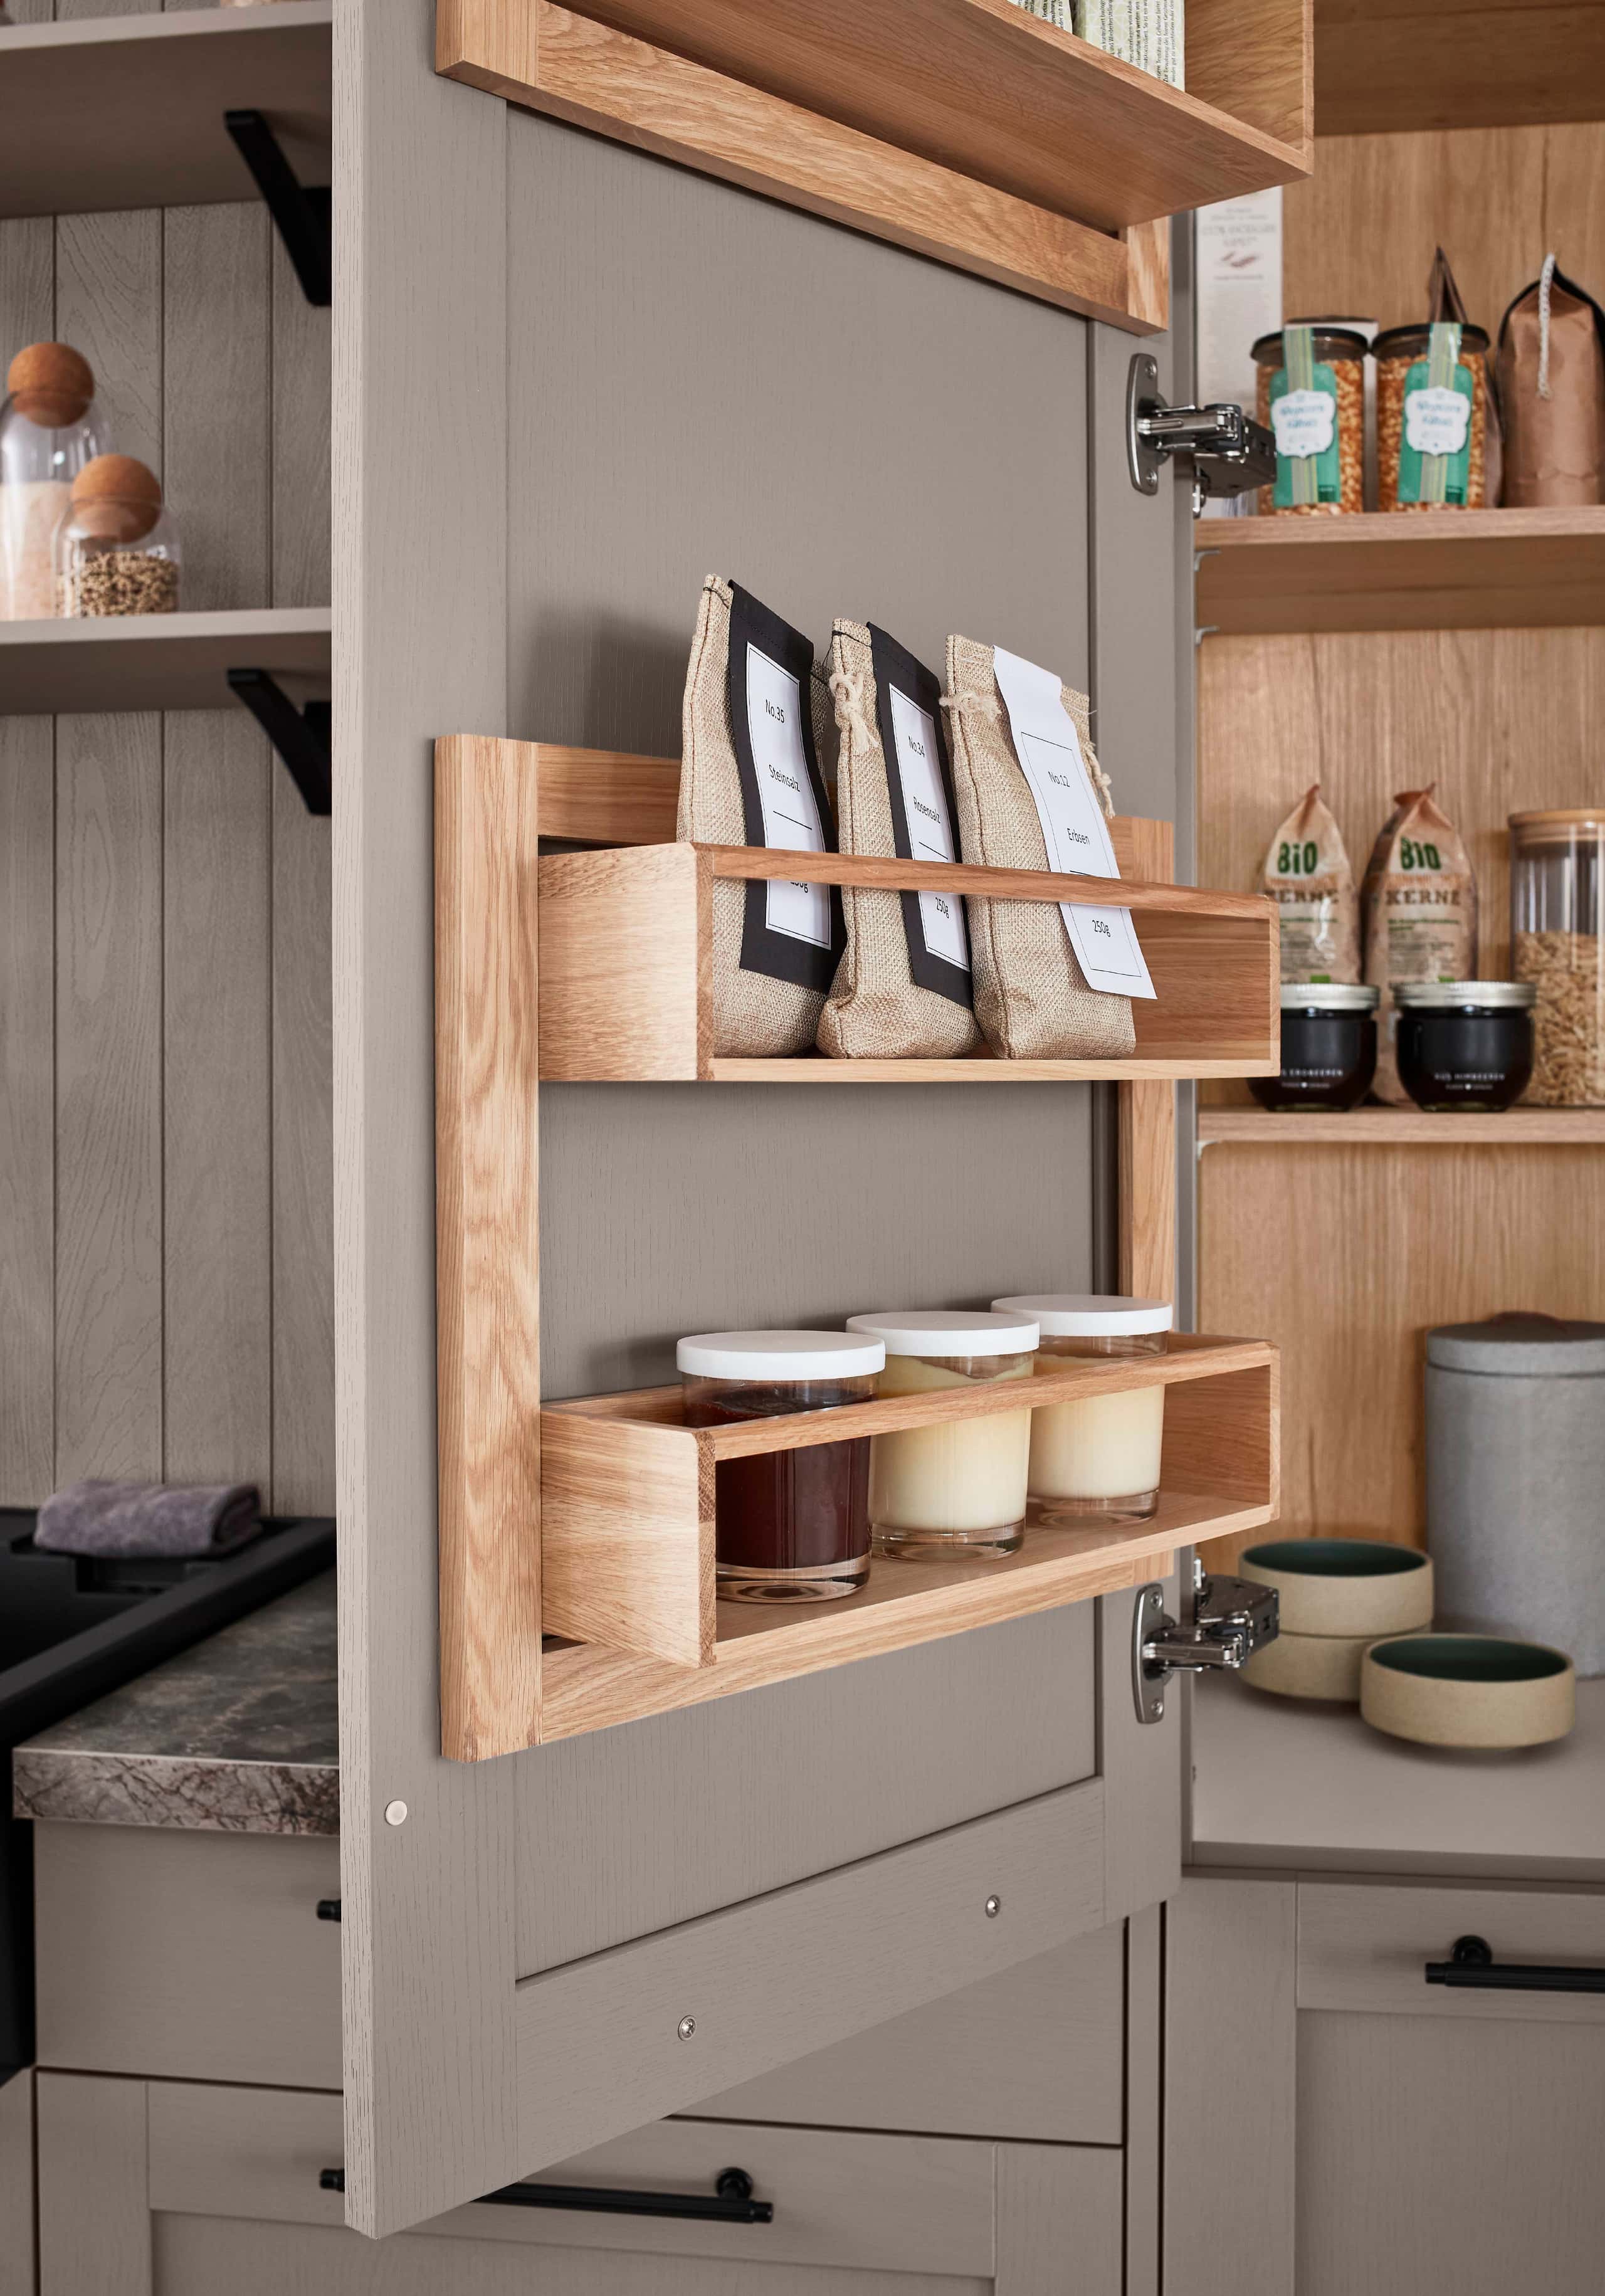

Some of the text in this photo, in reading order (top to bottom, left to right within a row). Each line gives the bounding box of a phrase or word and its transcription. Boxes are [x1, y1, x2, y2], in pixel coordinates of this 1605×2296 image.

[766, 699, 785, 724] No.35
[908, 735, 925, 757] No.34
[769, 764, 801, 793] Steinsalz
[1048, 771, 1070, 787] No.12
[913, 796, 941, 824] Rosensalz
[1067, 828, 1090, 845] Erbsen
[935, 897, 949, 919] 250g
[1386, 890, 1461, 906] KERNE
[1092, 920, 1111, 937] 250g
